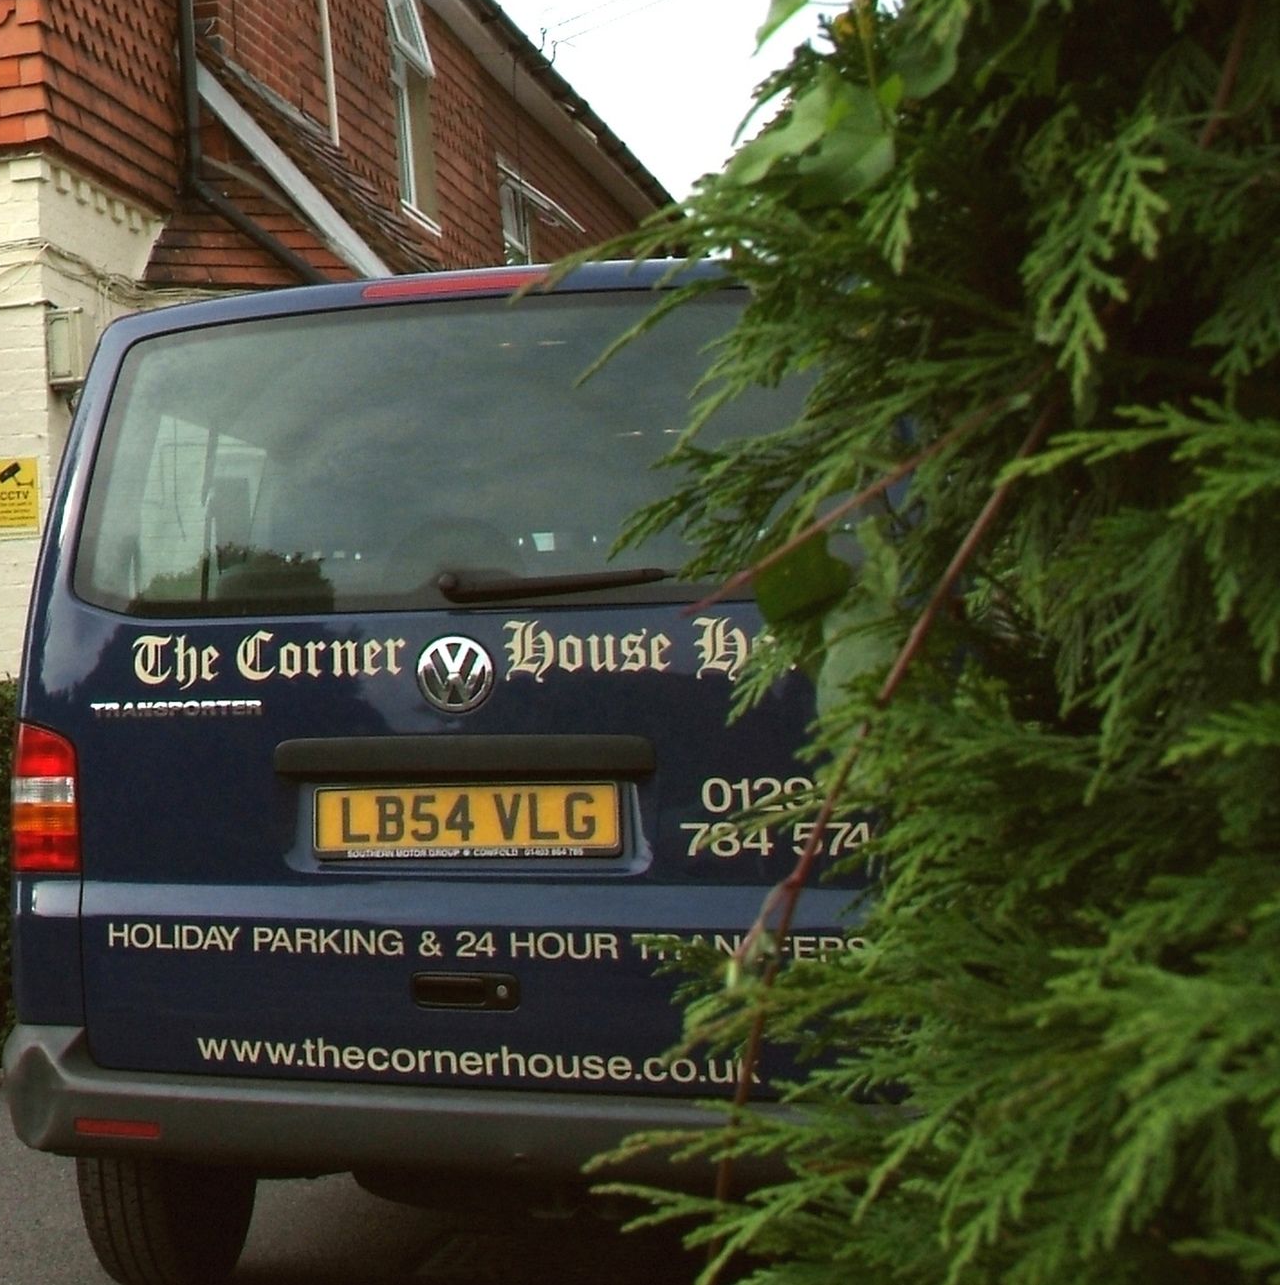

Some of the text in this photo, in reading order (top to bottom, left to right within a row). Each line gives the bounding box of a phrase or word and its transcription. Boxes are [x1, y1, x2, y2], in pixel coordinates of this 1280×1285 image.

[0, 490, 30, 501] CCTV
[132, 632, 220, 691] The
[236, 629, 407, 682] Corner
[502, 619, 674, 684] House
[90, 699, 263, 717] TRANSPORTER
[701, 777, 826, 813] 0129
[341, 791, 597, 844] LB54 VLG
[680, 822, 870, 857] 784 574
[108, 923, 240, 951] HOLIDAY
[253, 926, 404, 956] PARKING
[418, 930, 443, 957] &
[455, 930, 496, 958] 24
[510, 932, 619, 960] HOUR
